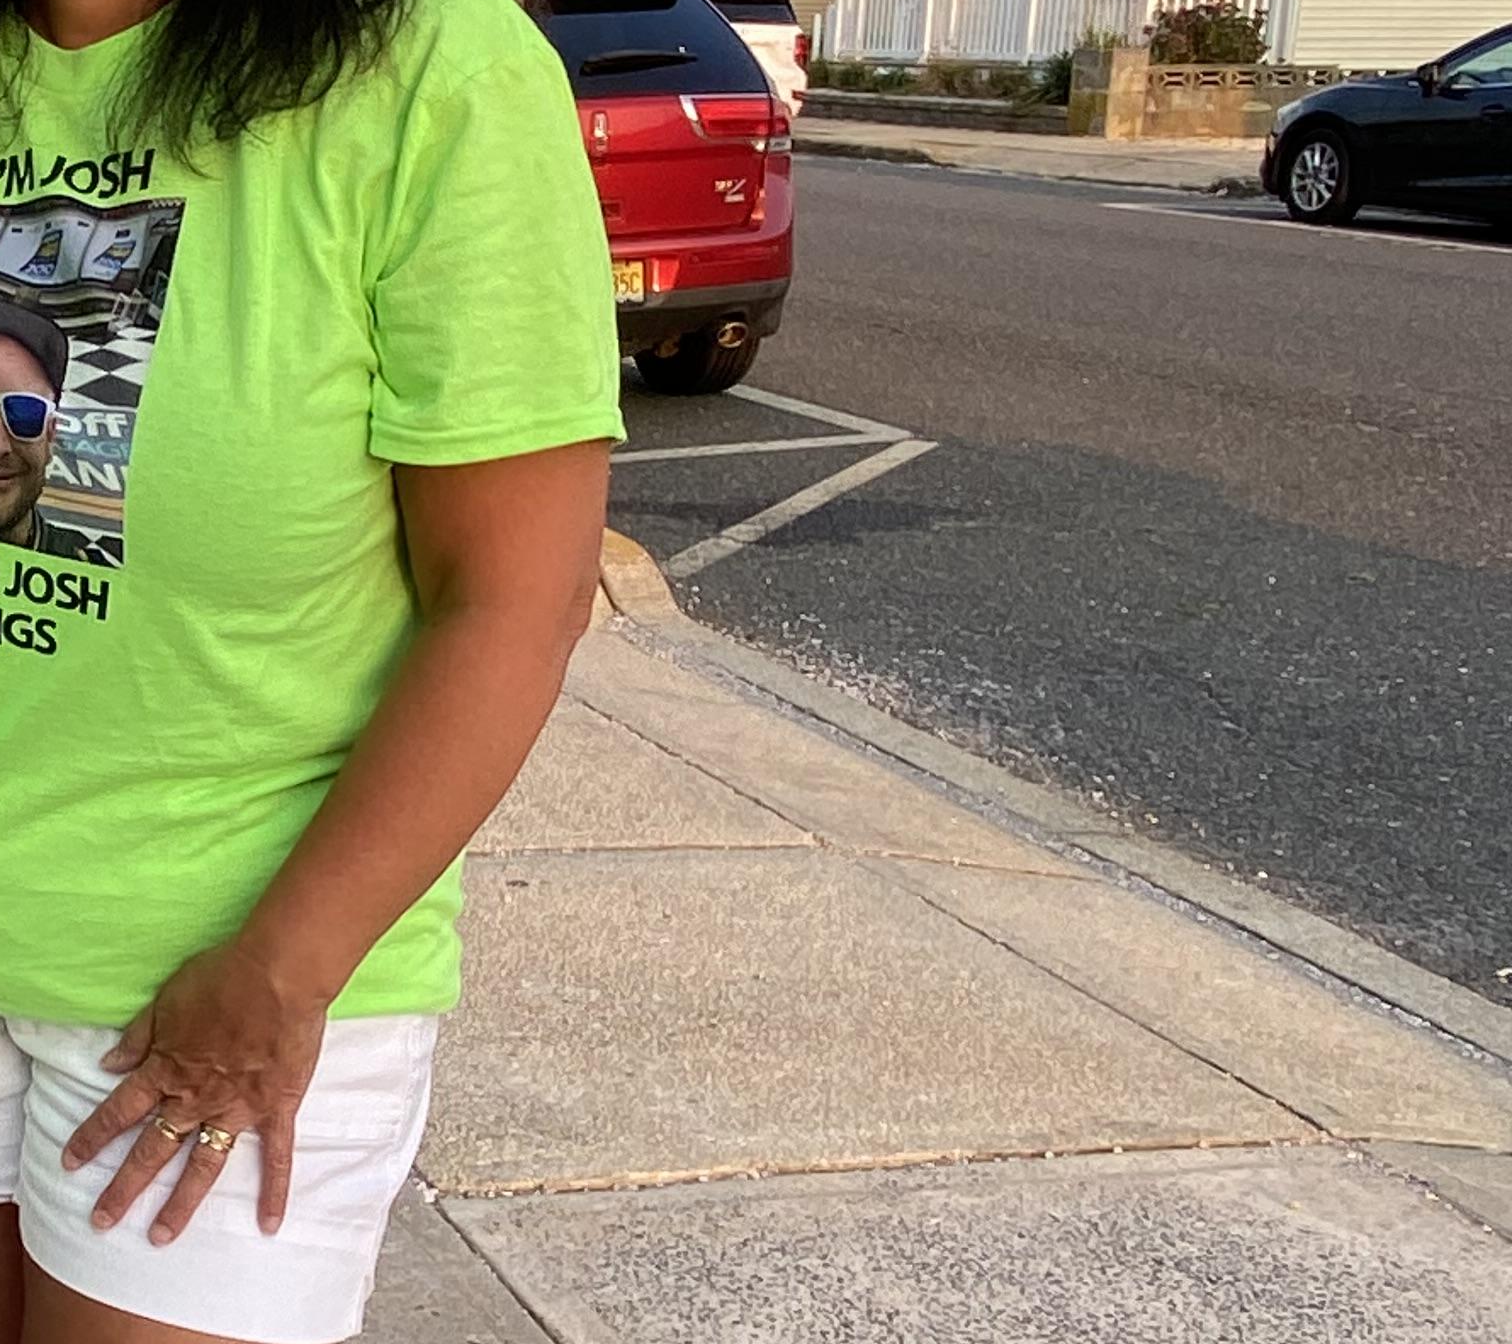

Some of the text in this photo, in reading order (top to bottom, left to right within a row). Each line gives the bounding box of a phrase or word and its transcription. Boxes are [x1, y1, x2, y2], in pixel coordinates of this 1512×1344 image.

[39, 148, 156, 199] JOSH
[45, 455, 129, 491] AN
[4, 561, 110, 621] JOSH
